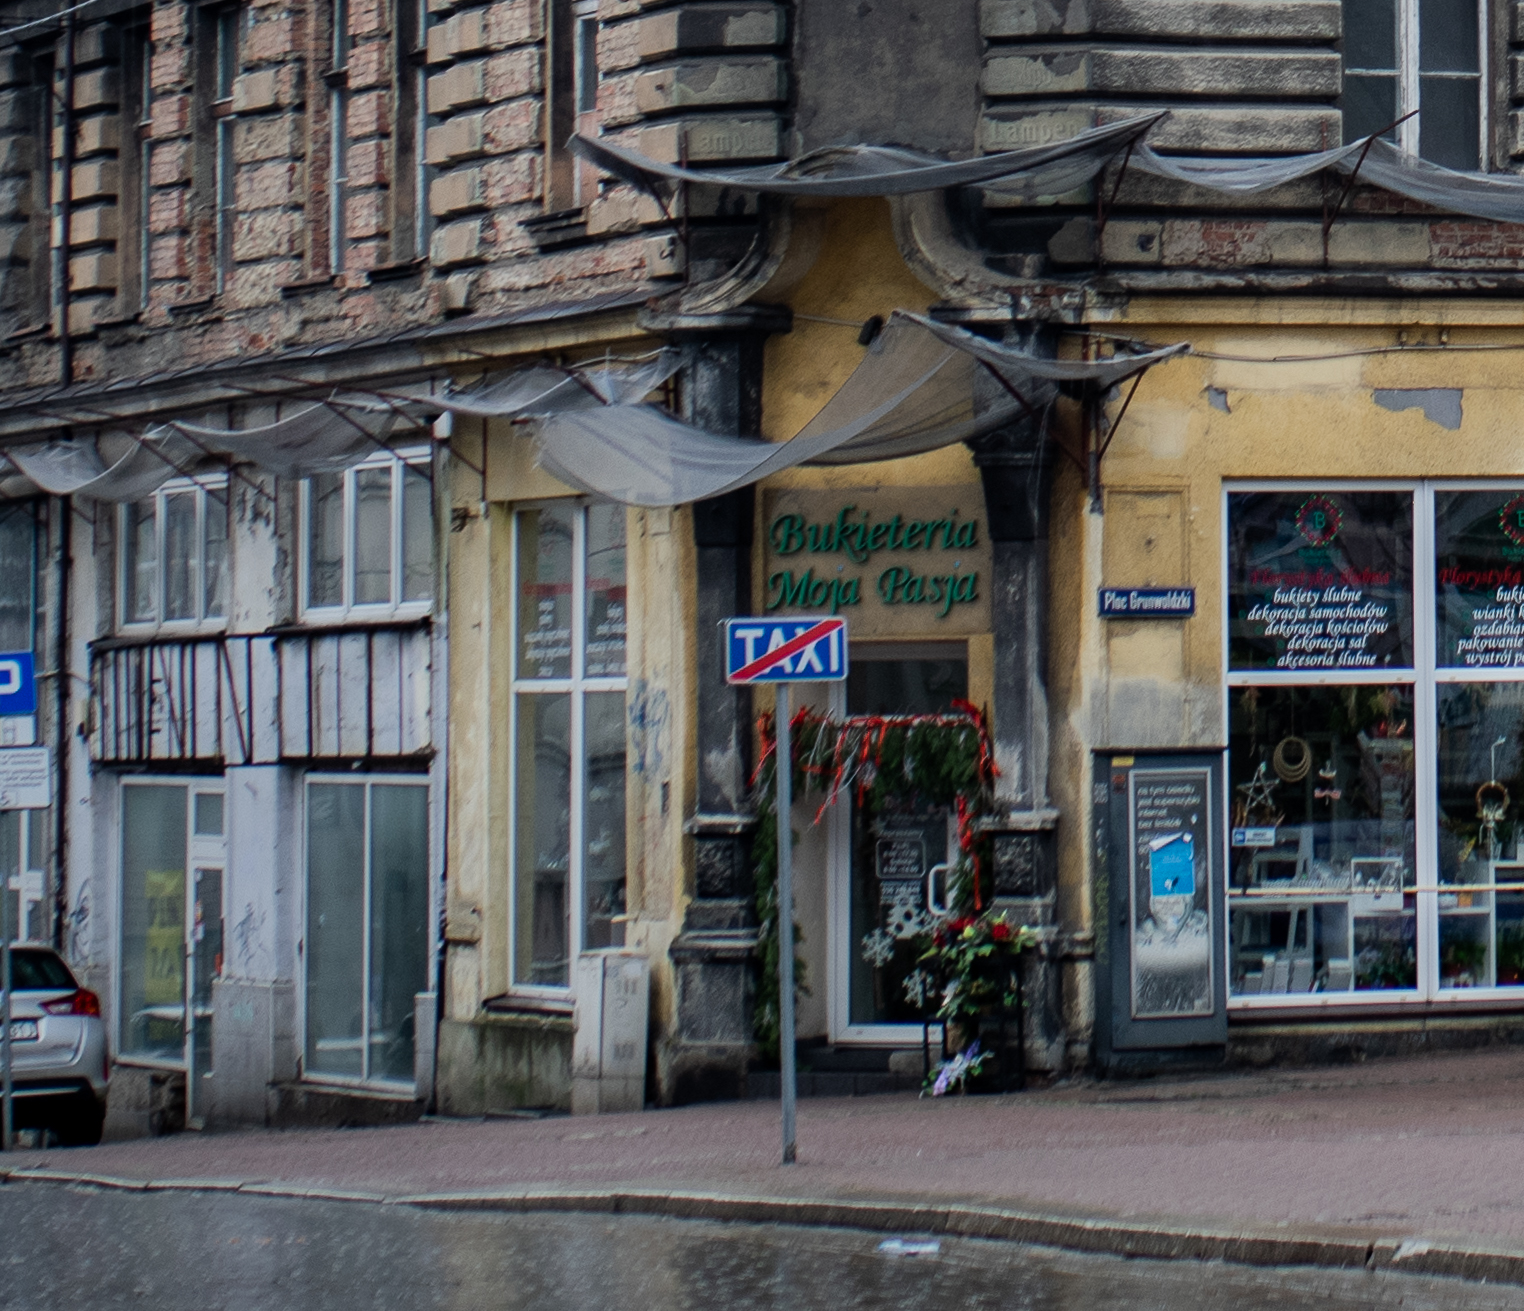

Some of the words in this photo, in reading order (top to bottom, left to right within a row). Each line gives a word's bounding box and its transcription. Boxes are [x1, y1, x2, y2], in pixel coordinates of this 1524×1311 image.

[1313, 511, 1326, 529] B
[769, 505, 978, 564] Bukieteria
[1439, 565, 1521, 590] Florystyka
[766, 567, 860, 616] Moja
[877, 565, 979, 619] Pasja
[1104, 590, 1127, 610] Plac
[1273, 587, 1320, 607] bukiety
[1322, 586, 1362, 603] ślubne
[1247, 604, 1306, 623] dekoracja
[1309, 601, 1388, 618] samochodów
[1472, 604, 1516, 621] wianki
[1265, 621, 1323, 640] dekoracja
[1326, 618, 1388, 637] kościołów
[735, 627, 839, 675] TAXI
[1287, 634, 1346, 652] dekoracja
[1349, 633, 1368, 649] sal
[1457, 636, 1524, 655] pakowanie
[1276, 651, 1334, 669] akcesoria
[1337, 649, 1377, 666] ślubne
[1465, 650, 1512, 667] wystrój
